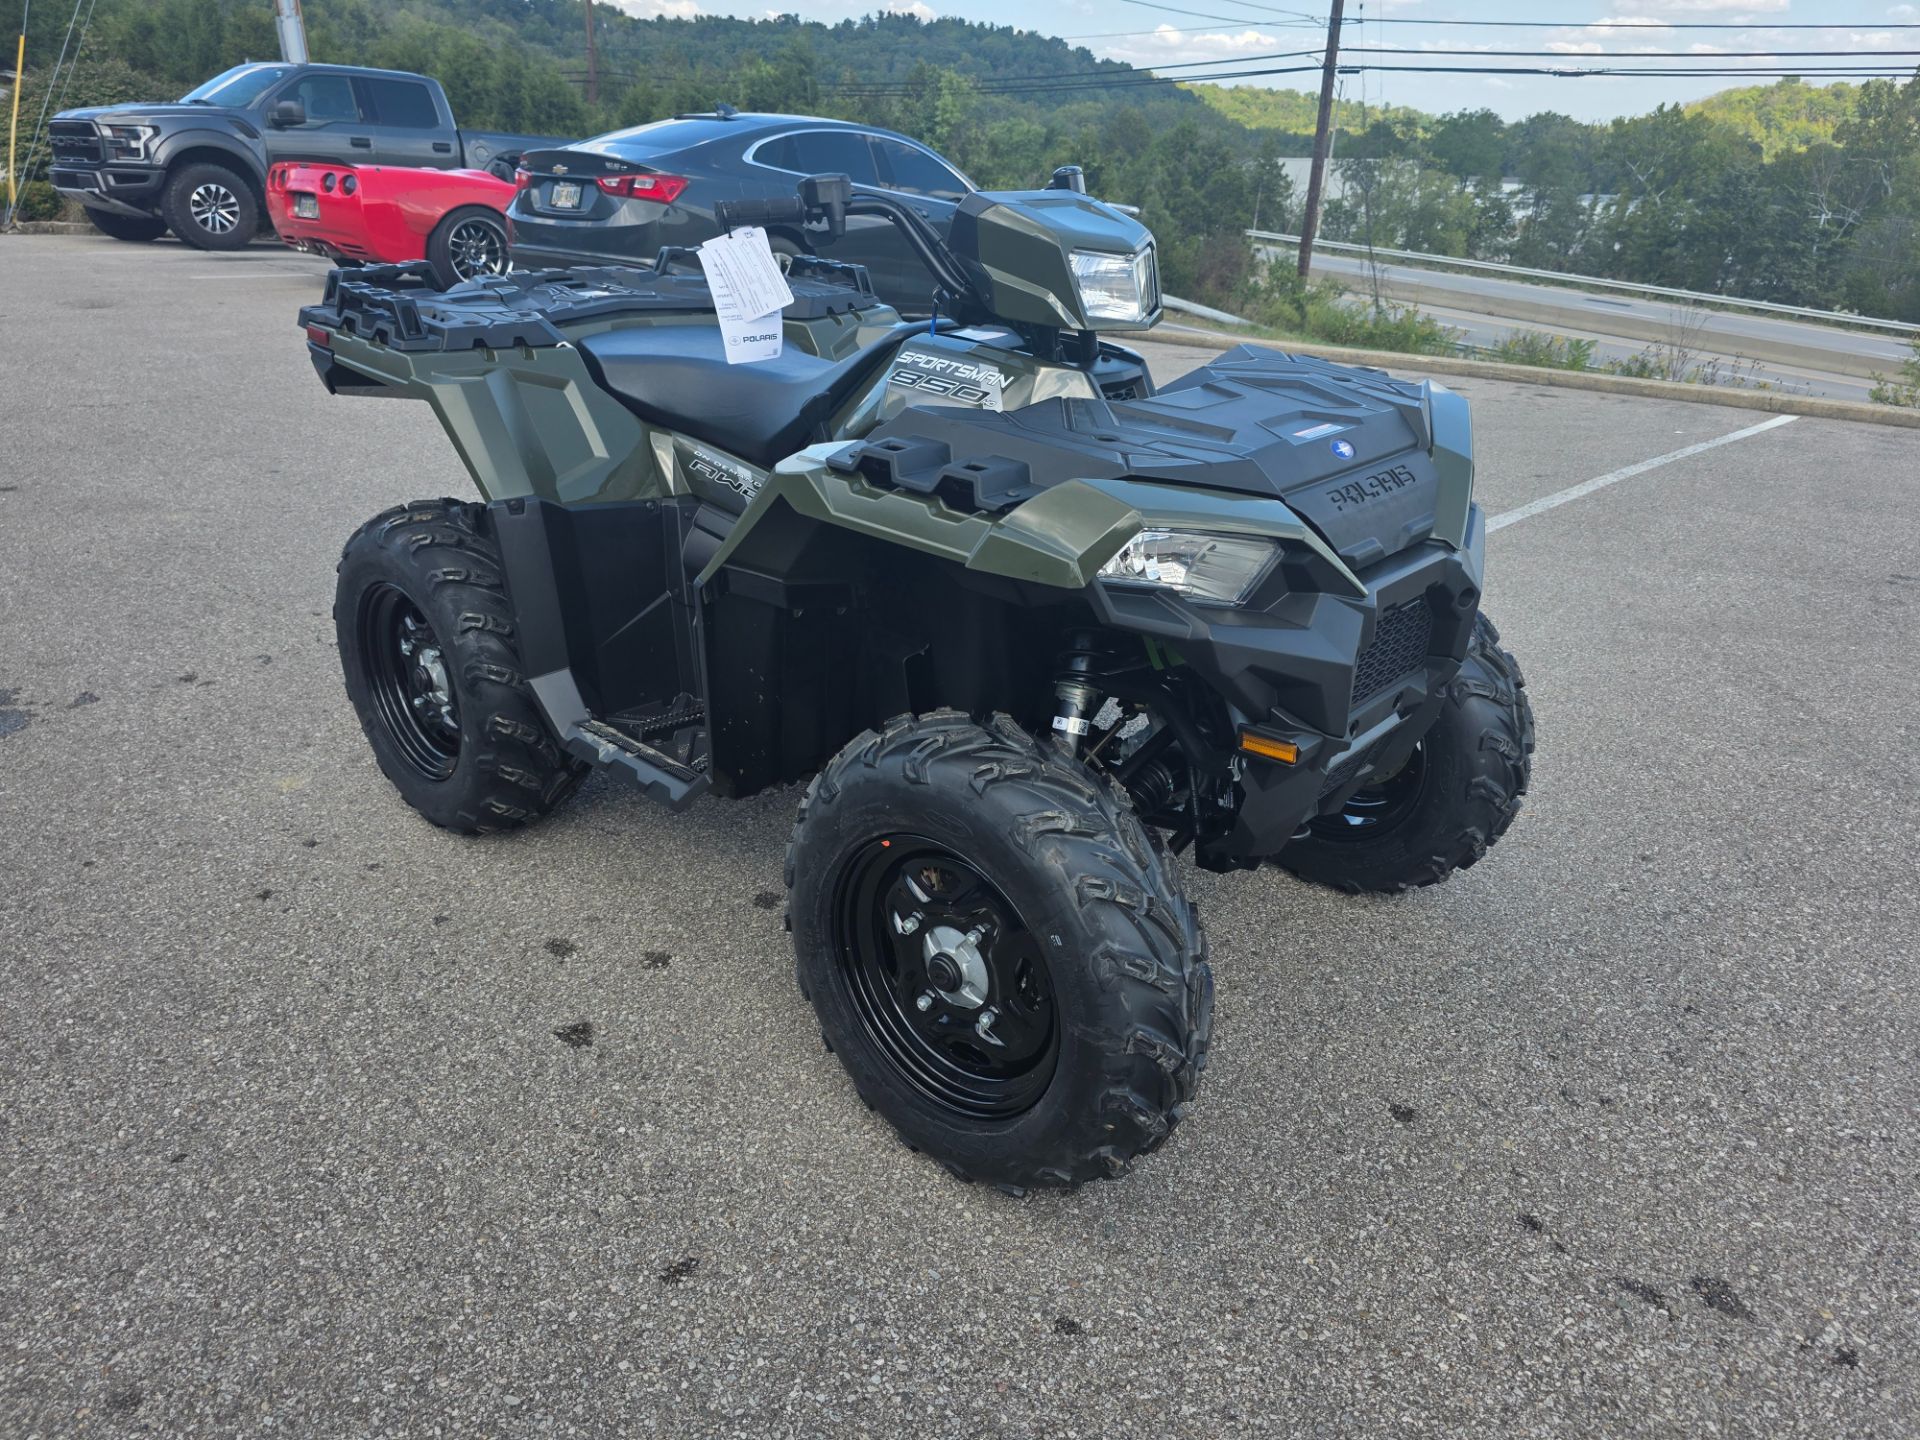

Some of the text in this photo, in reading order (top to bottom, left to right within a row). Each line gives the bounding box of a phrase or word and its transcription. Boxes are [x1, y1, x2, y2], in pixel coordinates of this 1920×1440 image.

[742, 333, 778, 343] POLARIS
[886, 368, 992, 404] 850
[895, 351, 1015, 389] SPORTSMAN
[694, 450, 763, 488] ON DEMAND
[1325, 464, 1417, 512] POLARIS
